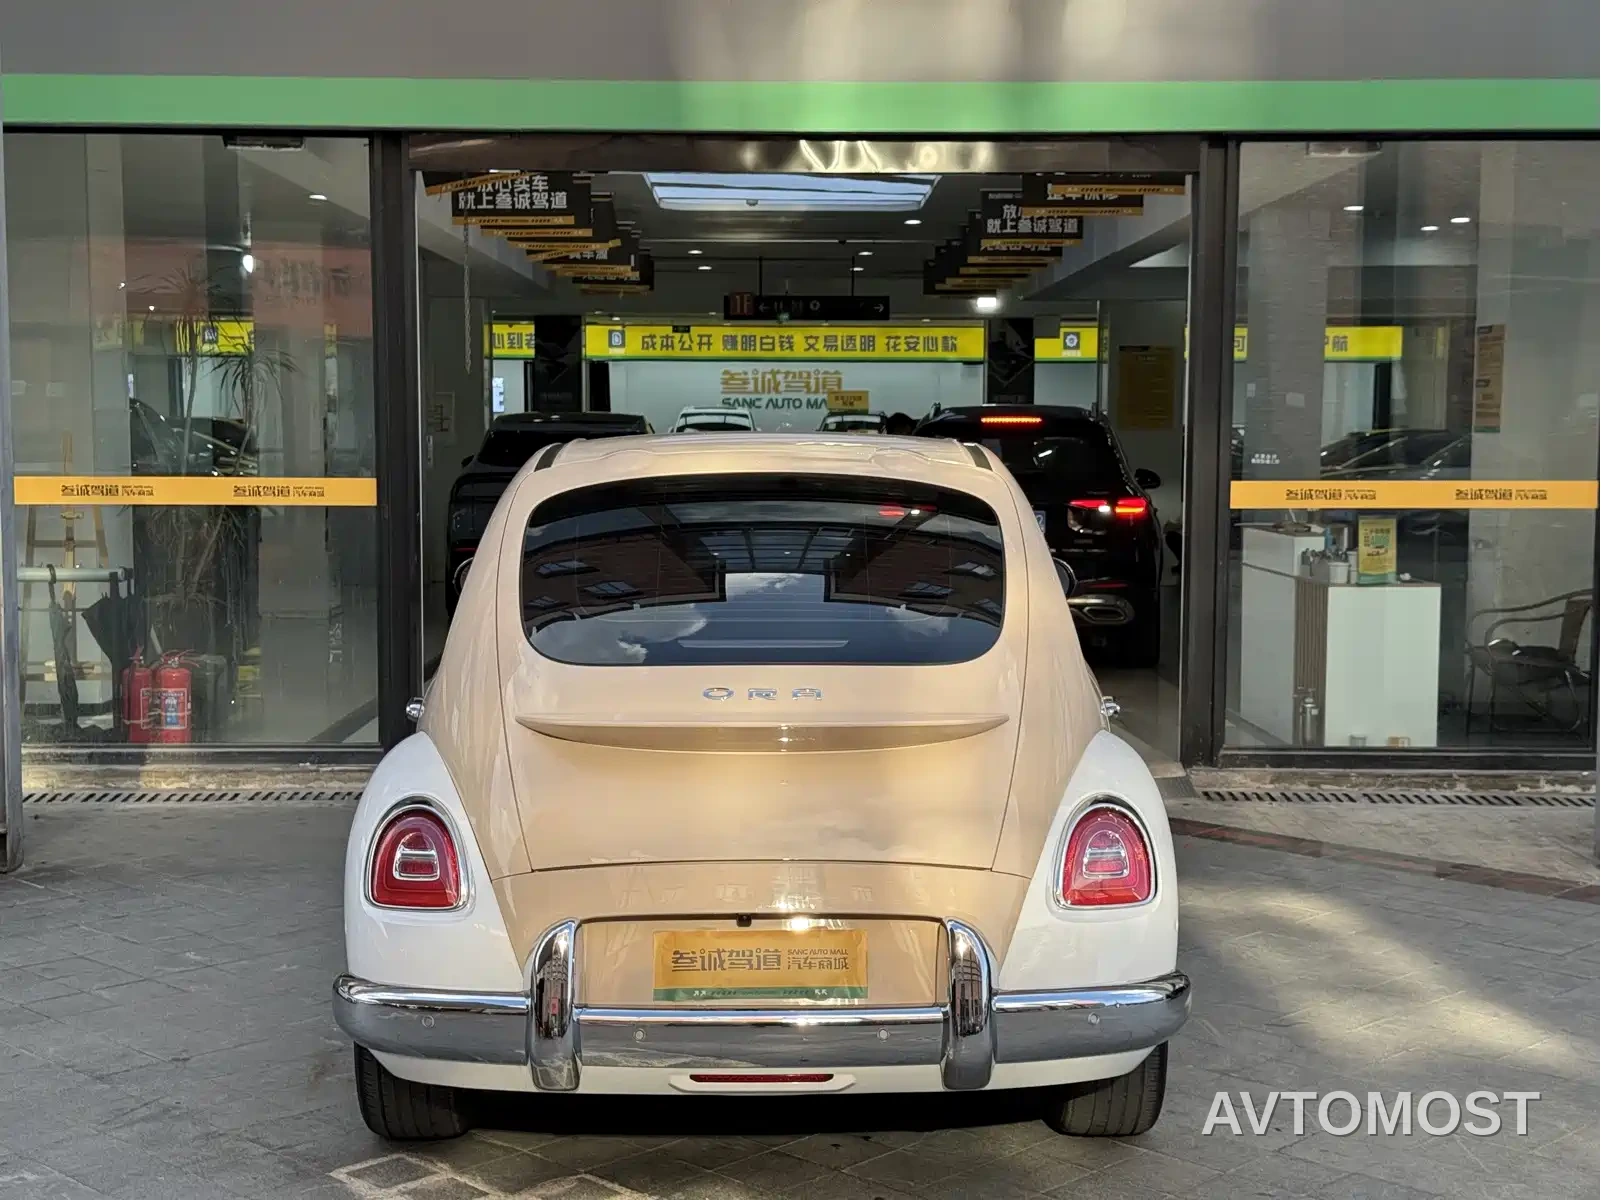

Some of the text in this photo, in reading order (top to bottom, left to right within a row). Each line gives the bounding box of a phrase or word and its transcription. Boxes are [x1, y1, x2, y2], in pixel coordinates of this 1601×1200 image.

[641, 334, 713, 351] 成本公开
[722, 398, 762, 410] SANC
[765, 398, 803, 410] AUTO
[703, 687, 822, 700] ORA
[672, 948, 781, 971] 叁诚驾道
[787, 956, 850, 970] 汽车商城
